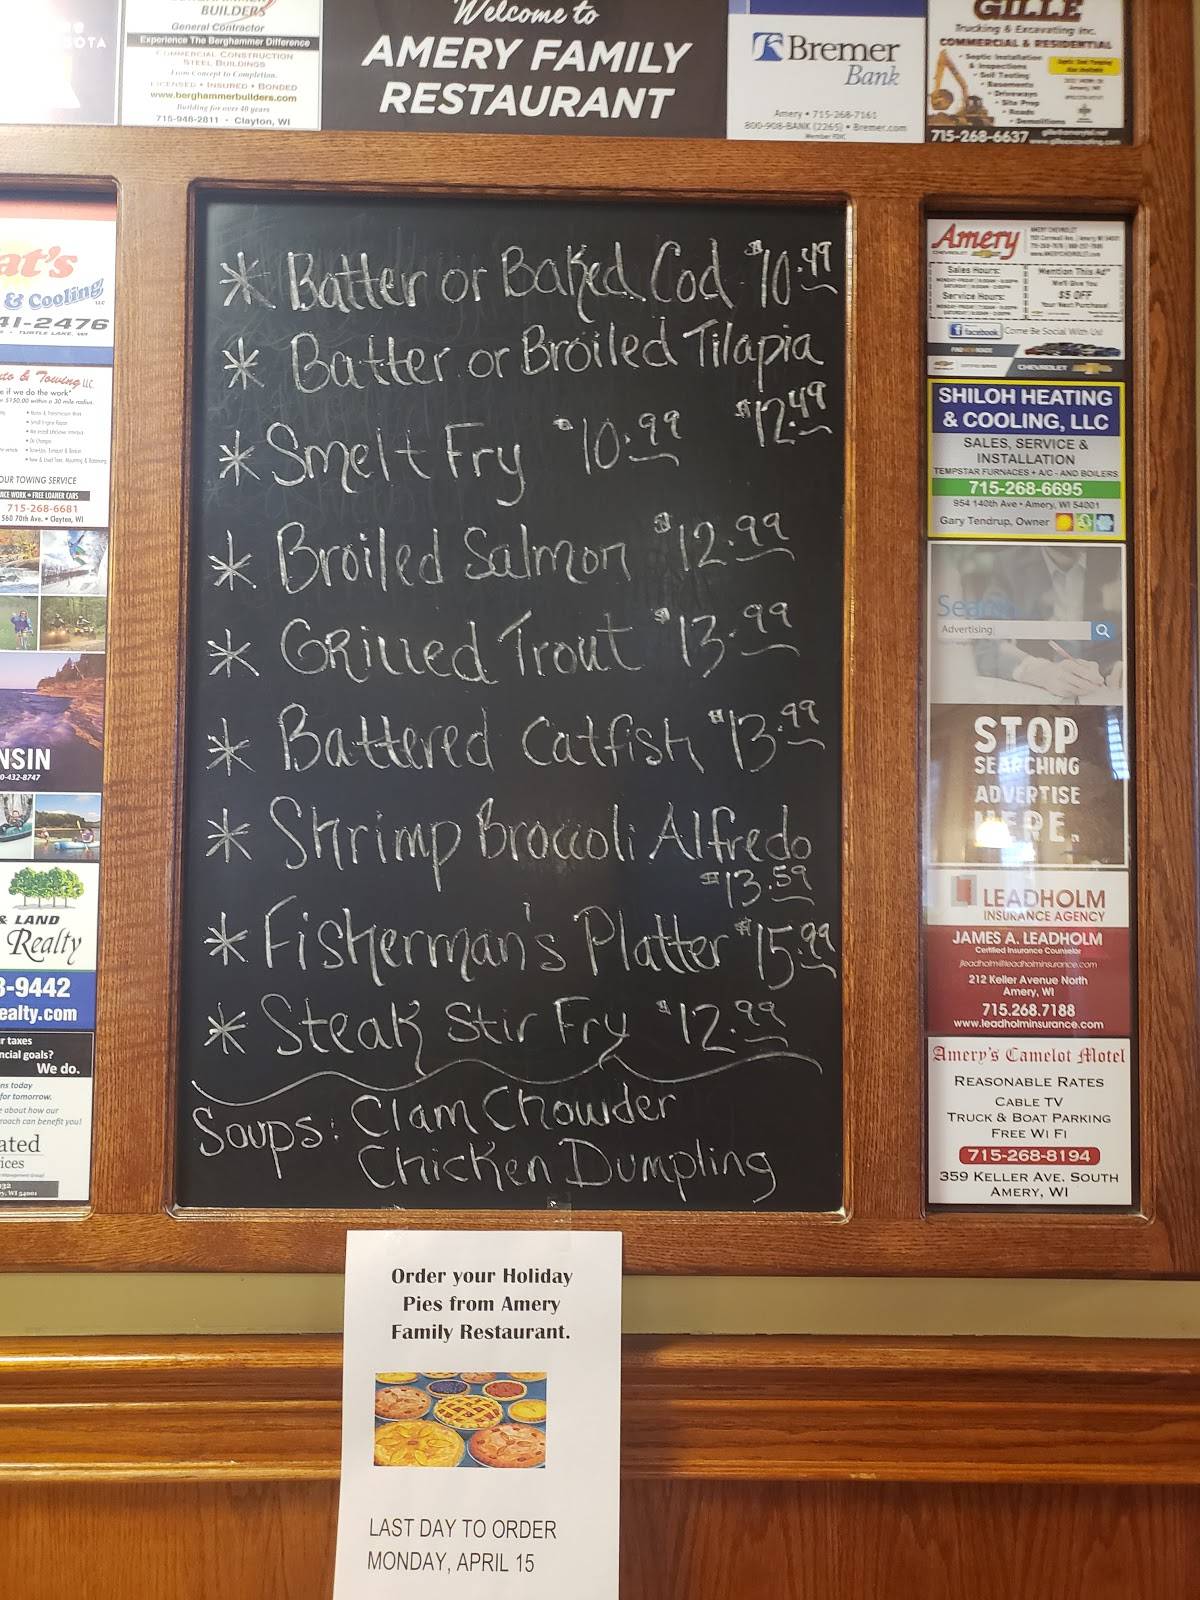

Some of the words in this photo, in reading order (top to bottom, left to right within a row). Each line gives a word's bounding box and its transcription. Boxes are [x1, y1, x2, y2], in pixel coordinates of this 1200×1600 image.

[452, 0, 568, 25] Welcome
[570, 1, 601, 26] to
[974, 0, 1084, 22] GILLE
[172, 23, 209, 32] General
[212, 23, 265, 32] Contractor
[140, 36, 188, 46] Experience
[189, 37, 206, 45] The
[208, 37, 263, 47] Berghammer
[266, 38, 310, 48] Difference
[788, 35, 900, 62] Bremer
[940, 38, 1018, 47] COMMERCIAL
[361, 35, 524, 70] AMERY
[530, 39, 695, 74] FAMILY
[845, 64, 900, 86] Bank
[150, 91, 297, 103] www.berghammerbuilders.com
[379, 81, 676, 119] RESTAURANT
[234, 117, 274, 126] Clayton,
[277, 118, 291, 126] WI
[813, 111, 878, 119] 715-268-7161
[931, 129, 1030, 143] 715-268-6637
[931, 223, 1020, 260] Amery
[288, 251, 428, 313] Batter
[441, 268, 487, 303] or
[501, 245, 647, 323] Baked
[651, 240, 734, 309] Cod
[28, 278, 104, 310] Cooling
[1059, 291, 1071, 299] $5
[1074, 291, 1093, 299] OFF
[291, 332, 451, 394] Batter
[468, 347, 510, 378] or
[523, 315, 679, 375] Broiled
[683, 318, 824, 393] Tilapia
[938, 387, 1016, 405] SHILOH
[1021, 389, 1113, 406] HEATING
[962, 412, 1065, 432] COOLING,
[1071, 414, 1109, 430] LLC
[964, 438, 1011, 450] SALES,
[1016, 438, 1075, 449] SERVICE
[266, 421, 432, 494] Smelt
[445, 422, 526, 507] Fry
[977, 453, 1075, 465] INSTALLATION
[935, 467, 980, 475] TEMPSTAR
[982, 468, 1030, 476] FURNACES
[16, 476, 46, 484] TOWING
[48, 476, 77, 485] SERVICE
[969, 481, 1083, 496] 715-268-6695
[8, 504, 78, 513] 715-268-6681
[940, 517, 964, 527] Gary
[967, 517, 1012, 527] Tendrup,
[1016, 518, 1050, 526] Owner
[277, 521, 443, 594] Broiled
[464, 524, 631, 584] Salmon
[942, 625, 993, 635] Advertising
[498, 609, 645, 677] Trout
[278, 702, 494, 772] Battered
[522, 714, 704, 774] Catfish
[974, 716, 1079, 754] STOP
[974, 756, 1081, 776] SEARCHING
[975, 785, 1081, 805] ADVERTISE
[270, 796, 462, 892] Shrimp
[649, 801, 812, 863] Alfredo
[983, 889, 1105, 908] LEADHOLM
[14, 915, 60, 925] LAND
[984, 911, 1051, 921] INSURANCE
[1054, 911, 1105, 922] AGENCY
[265, 895, 567, 982] Fisherman's
[574, 905, 729, 976] Platter
[952, 931, 1001, 944] JAMES
[1005, 932, 1020, 944] A.
[1023, 932, 1103, 945] LEADHOLM
[7, 928, 82, 966] Realty
[968, 975, 987, 984] 212
[989, 975, 1017, 985] Keller
[1020, 976, 1059, 985] Avenue
[1061, 976, 1088, 985] North
[1003, 987, 1039, 997] Amery,
[1042, 987, 1054, 996] WI
[0, 1005, 77, 1024] ealty.com
[982, 1003, 1076, 1017] 715.268.7188
[954, 1019, 1104, 1029] www.leadholminsurance.com
[7, 1037, 32, 1045] taxes
[260, 993, 426, 1076] Steak
[446, 1002, 538, 1044] Stir
[554, 996, 630, 1068] Fry
[23, 1050, 54, 1061] goals?
[933, 1046, 999, 1065] Amery's
[1006, 1048, 1072, 1063] Camelot
[1077, 1048, 1126, 1064] Motel
[37, 1063, 57, 1074] We
[60, 1063, 80, 1074] do.
[11, 1082, 32, 1090] today
[954, 1076, 1052, 1087] REASONABLE
[1058, 1077, 1104, 1088] RATES
[995, 1097, 1040, 1107] CABLE
[1044, 1097, 1063, 1107] TV
[947, 1112, 992, 1122] TRUCK
[1012, 1113, 1048, 1123] BOAT
[1052, 1113, 1111, 1123] PARKING
[192, 1106, 339, 1180] Soups:
[351, 1094, 480, 1138] Clam
[482, 1082, 677, 1132] Chowder
[991, 1129, 1026, 1138] FREE
[968, 1149, 1091, 1162] 715-268-8194
[357, 1142, 552, 1192] Chicken
[558, 1138, 777, 1203] Dumpling
[939, 1171, 968, 1182] 359
[974, 1172, 1028, 1182] KELLER
[1033, 1172, 1065, 1182] AVE.
[1071, 1173, 1119, 1183] SOUTH
[990, 1187, 1044, 1198] AMERY,
[1049, 1188, 1068, 1197] WI
[391, 1268, 446, 1284] Order
[452, 1271, 496, 1287] your
[503, 1269, 573, 1287] Holiday
[402, 1296, 443, 1312] Pies
[450, 1296, 494, 1312] from
[501, 1297, 561, 1315] Amery
[391, 1324, 453, 1343] Family
[459, 1324, 571, 1340] Restaurant.
[369, 1518, 414, 1537] LAST
[420, 1519, 456, 1537] DAY
[462, 1519, 487, 1538] TO
[492, 1520, 557, 1539] ORDER
[367, 1551, 452, 1574] MONDAY,
[456, 1553, 509, 1572] APRIL
[516, 1554, 535, 1573] 15
